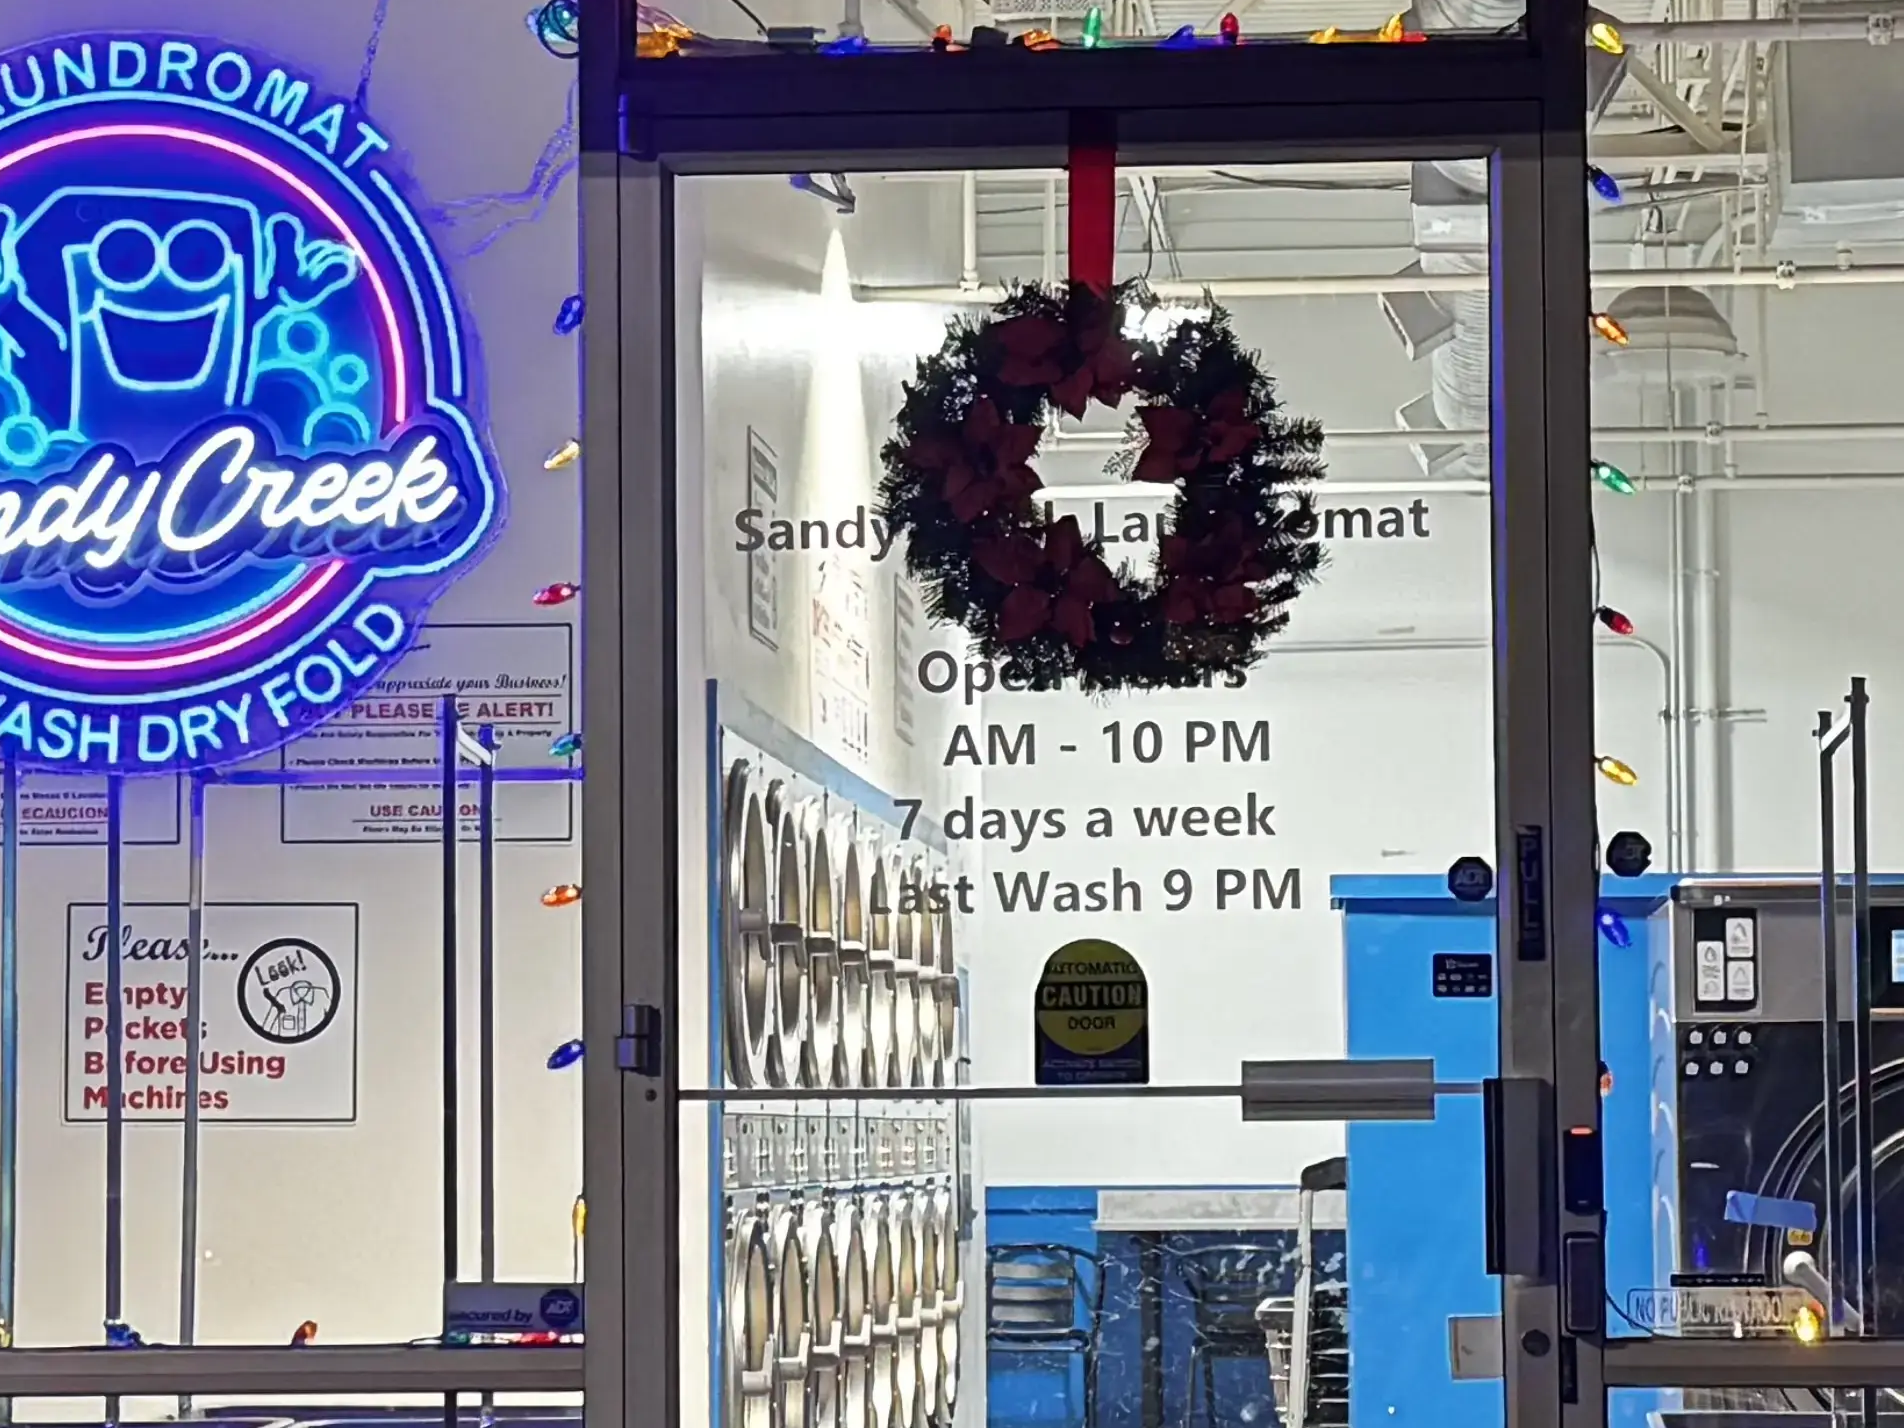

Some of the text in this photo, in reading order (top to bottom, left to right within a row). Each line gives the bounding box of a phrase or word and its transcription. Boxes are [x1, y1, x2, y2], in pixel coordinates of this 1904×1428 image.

[158, 425, 459, 551] Creek
[734, 505, 896, 562] Sandy
[137, 693, 251, 763] DRY
[262, 603, 404, 727] FOLD
[456, 679, 490, 693] your
[494, 673, 567, 690] Business!
[351, 703, 434, 719] PLEASE
[476, 701, 554, 718] ALERT!
[943, 723, 1036, 766] AM
[1102, 720, 1164, 764] 10
[1186, 719, 1271, 763] PM
[369, 804, 481, 817] USE CAUON
[893, 792, 1277, 853] 7 days a week
[869, 867, 1302, 914] Last Wash 9 PM
[1520, 837, 1540, 929] PULL
[1042, 984, 1142, 1007] CAUTION
[1068, 1016, 1116, 1031] DOOR
[84, 1049, 286, 1079] Bfore Using
[514, 1309, 534, 1323] by
[546, 1300, 574, 1316] ADT
[1635, 1296, 1655, 1322] NO
